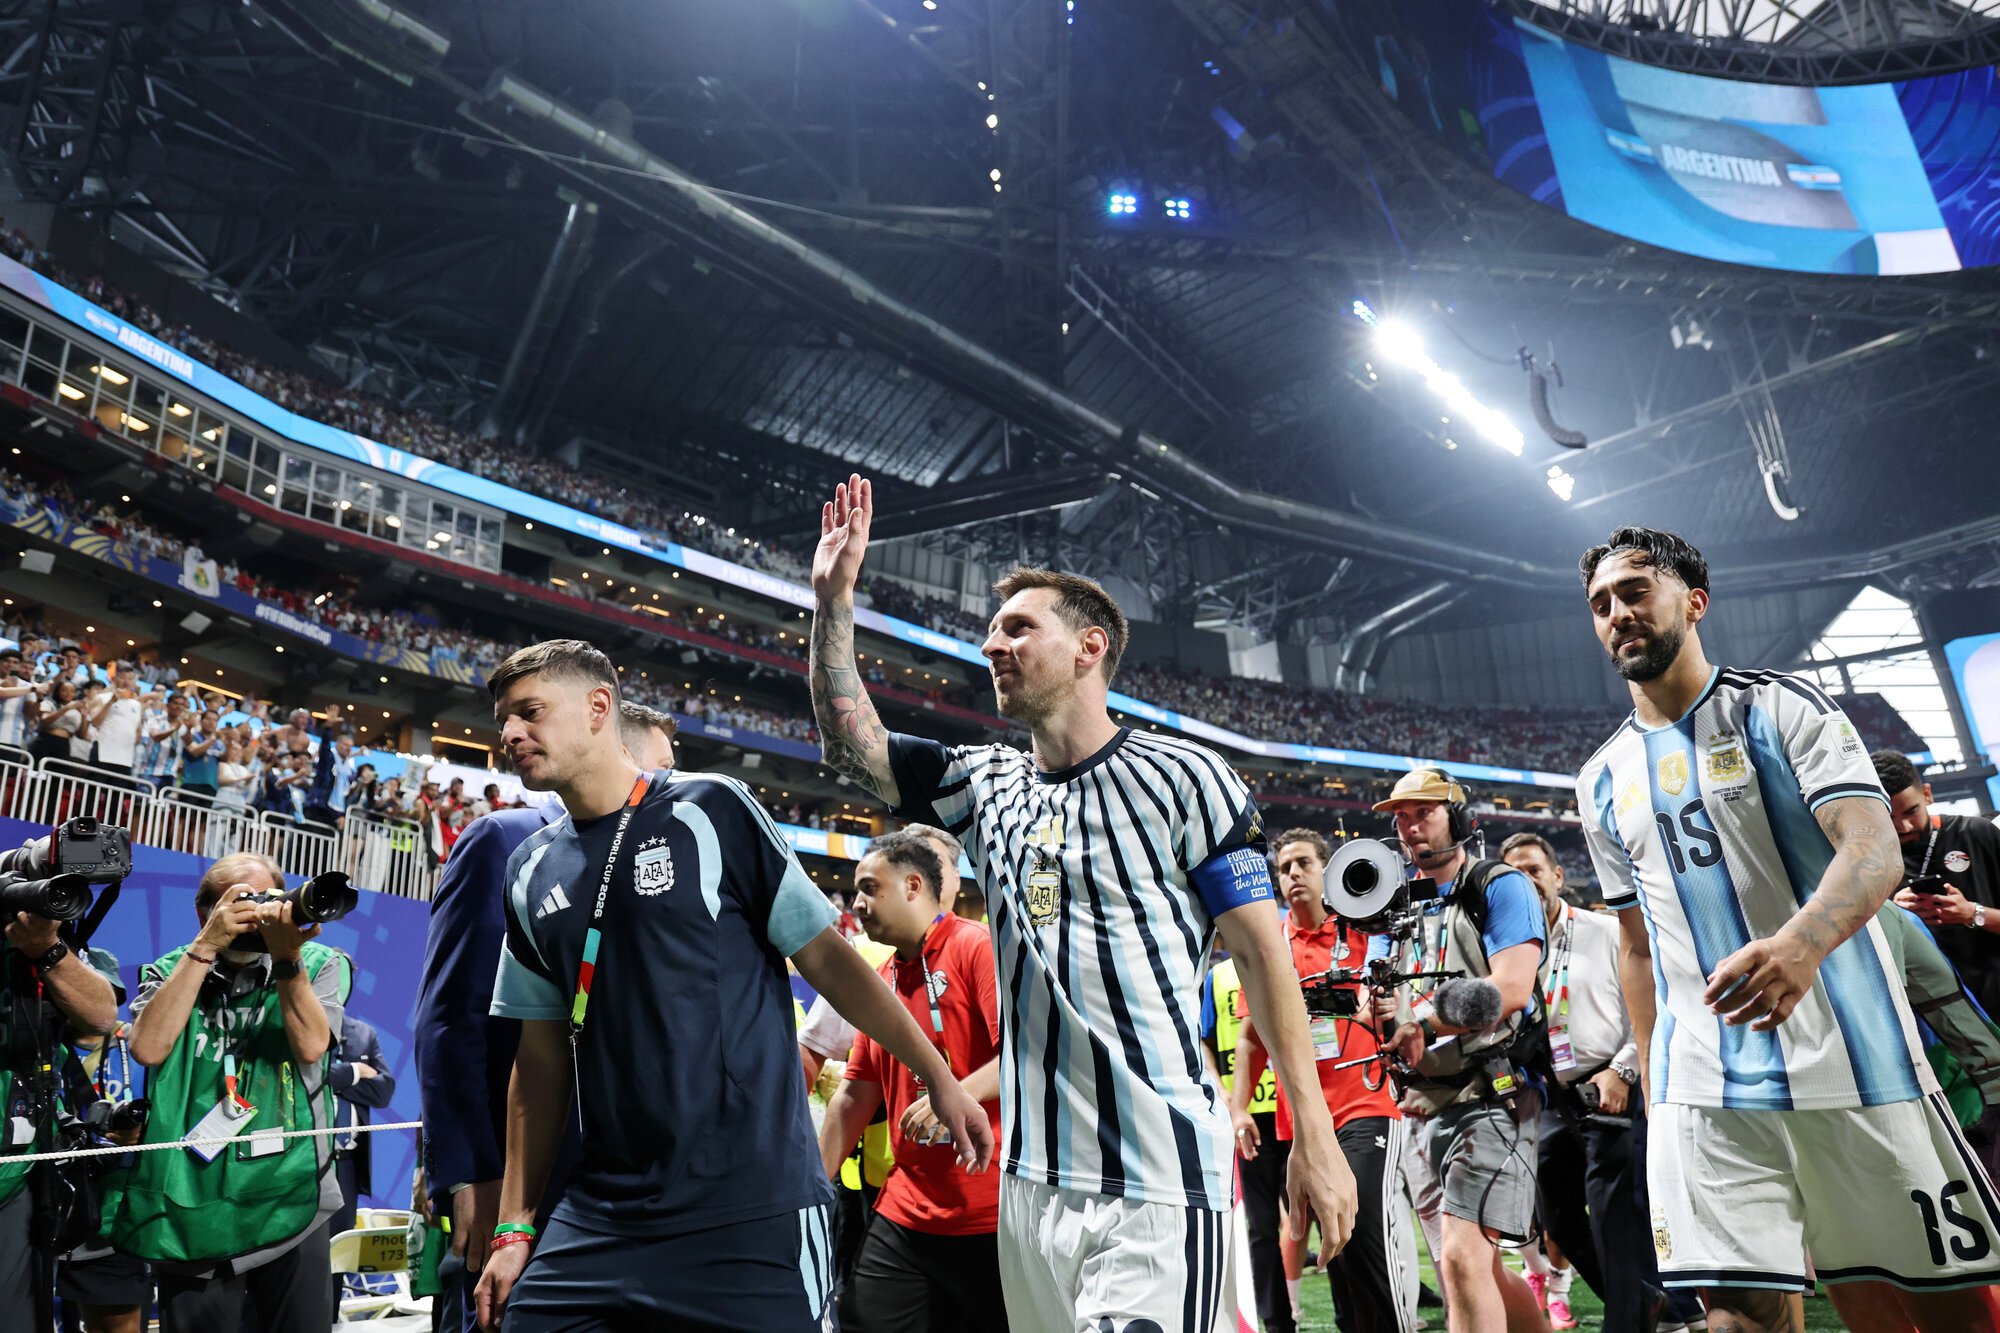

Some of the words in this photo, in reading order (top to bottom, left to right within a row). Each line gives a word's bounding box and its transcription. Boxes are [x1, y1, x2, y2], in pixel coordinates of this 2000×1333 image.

[1661, 144, 1782, 187] ARGENTINA
[118, 326, 193, 380] ARGENTINA
[255, 602, 332, 646] #FIFAWorldCup
[1713, 751, 1737, 770] AFA
[617, 812, 631, 831] FIFA
[607, 831, 625, 864] WORLD
[1655, 797, 1723, 875] 15
[602, 864, 614, 884] CUP
[642, 860, 665, 882] AFA
[1232, 877, 1251, 891] the
[1251, 888, 1267, 898] FIFA
[594, 883, 609, 918] 2026
[1031, 885, 1052, 910] AFA
[198, 1006, 265, 1031] HOTO
[1910, 1180, 1991, 1266] 15
[372, 1234, 406, 1247] Phot
[380, 1249, 404, 1262] 173
